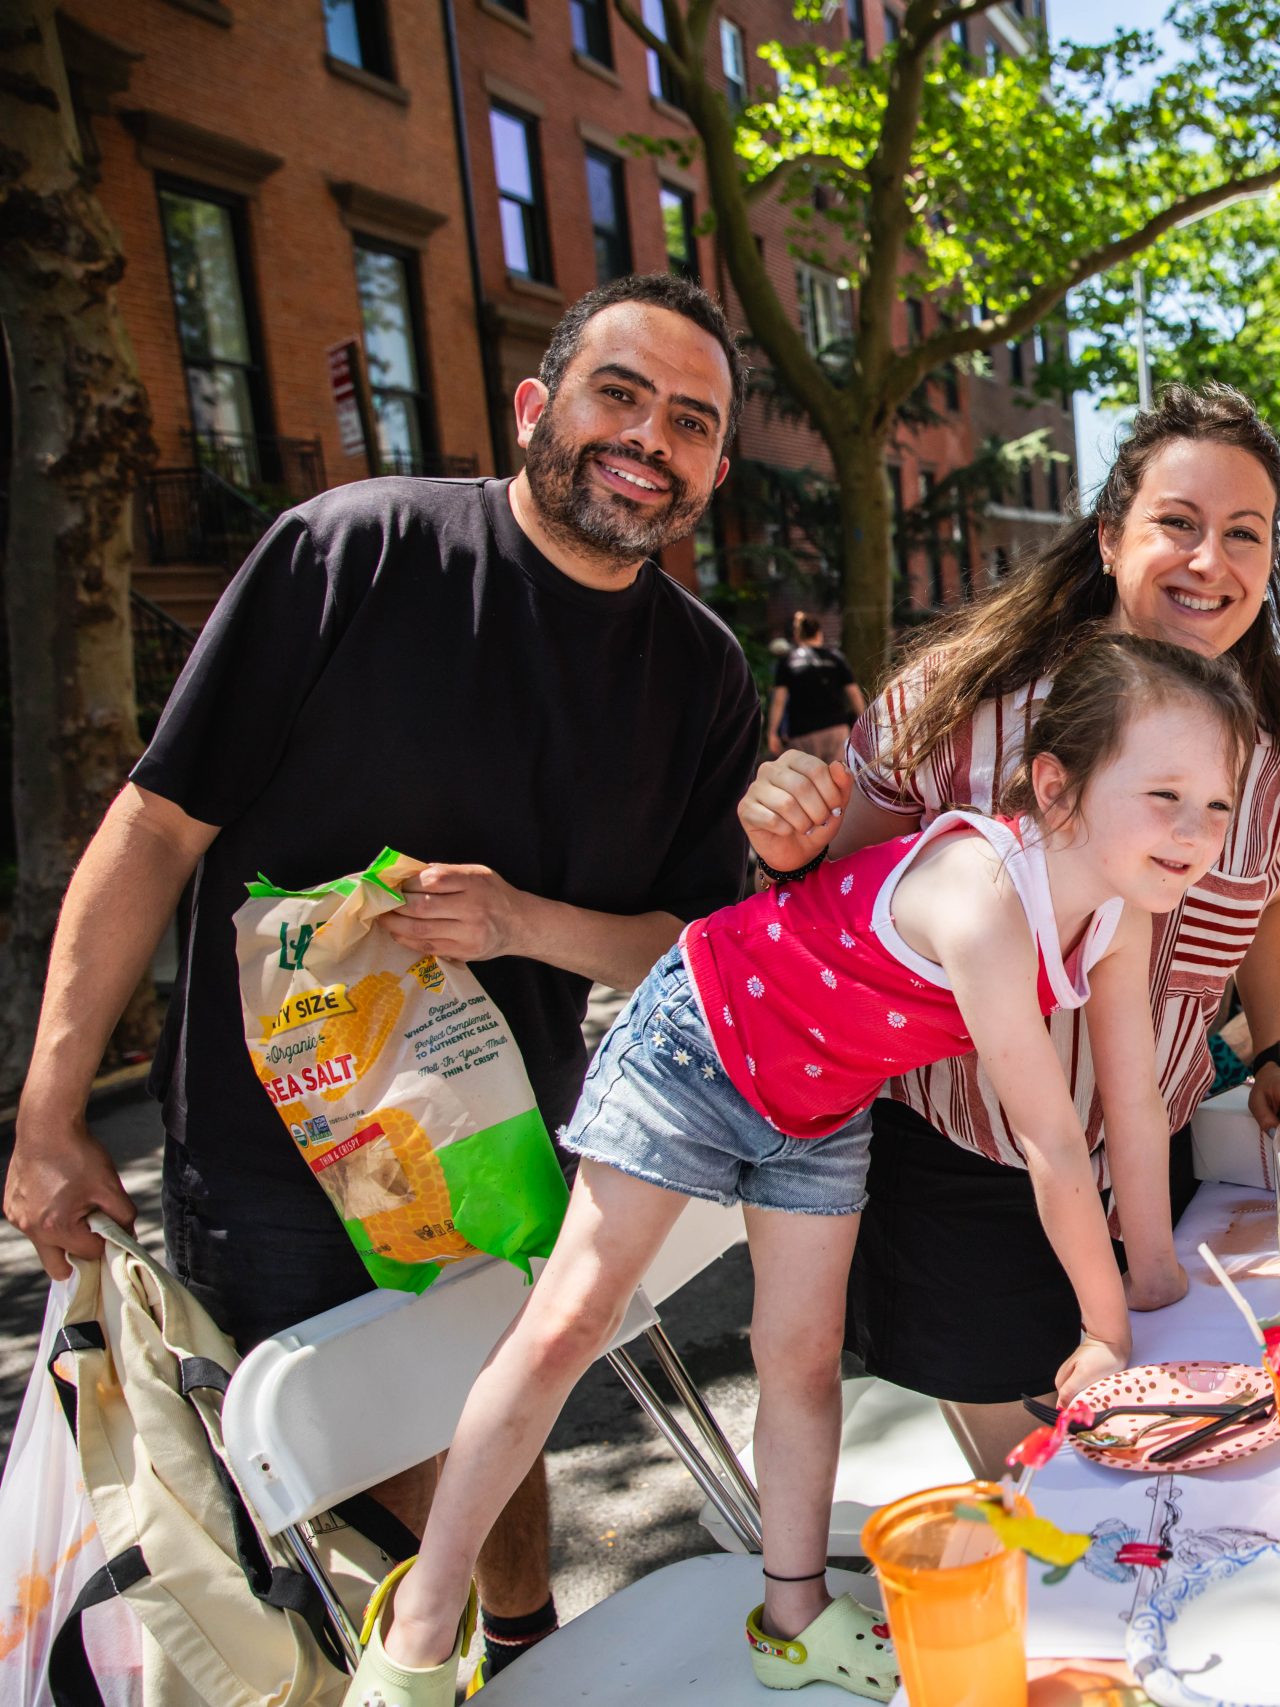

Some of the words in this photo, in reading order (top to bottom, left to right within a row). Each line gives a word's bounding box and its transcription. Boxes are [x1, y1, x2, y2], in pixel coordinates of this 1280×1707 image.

[279, 921, 328, 970] LA
[296, 992, 339, 1018] SIZE
[404, 1020, 434, 1039] WHOLE
[435, 1002, 467, 1022] GROUND
[468, 995, 487, 1006] CORN
[271, 1036, 318, 1064] Organic
[414, 1030, 446, 1053] Perfect
[446, 1011, 492, 1036] Complement
[416, 1051, 428, 1060] TO
[429, 1028, 476, 1054] AUTHENTIC
[477, 1020, 499, 1033] SALSA
[263, 1074, 304, 1103] SEA
[301, 1054, 352, 1091] SALT
[442, 1066, 464, 1079] THIN
[473, 1051, 499, 1067] CRISPY
[319, 1154, 334, 1167] THIN
[339, 1138, 360, 1156] CRISPY
